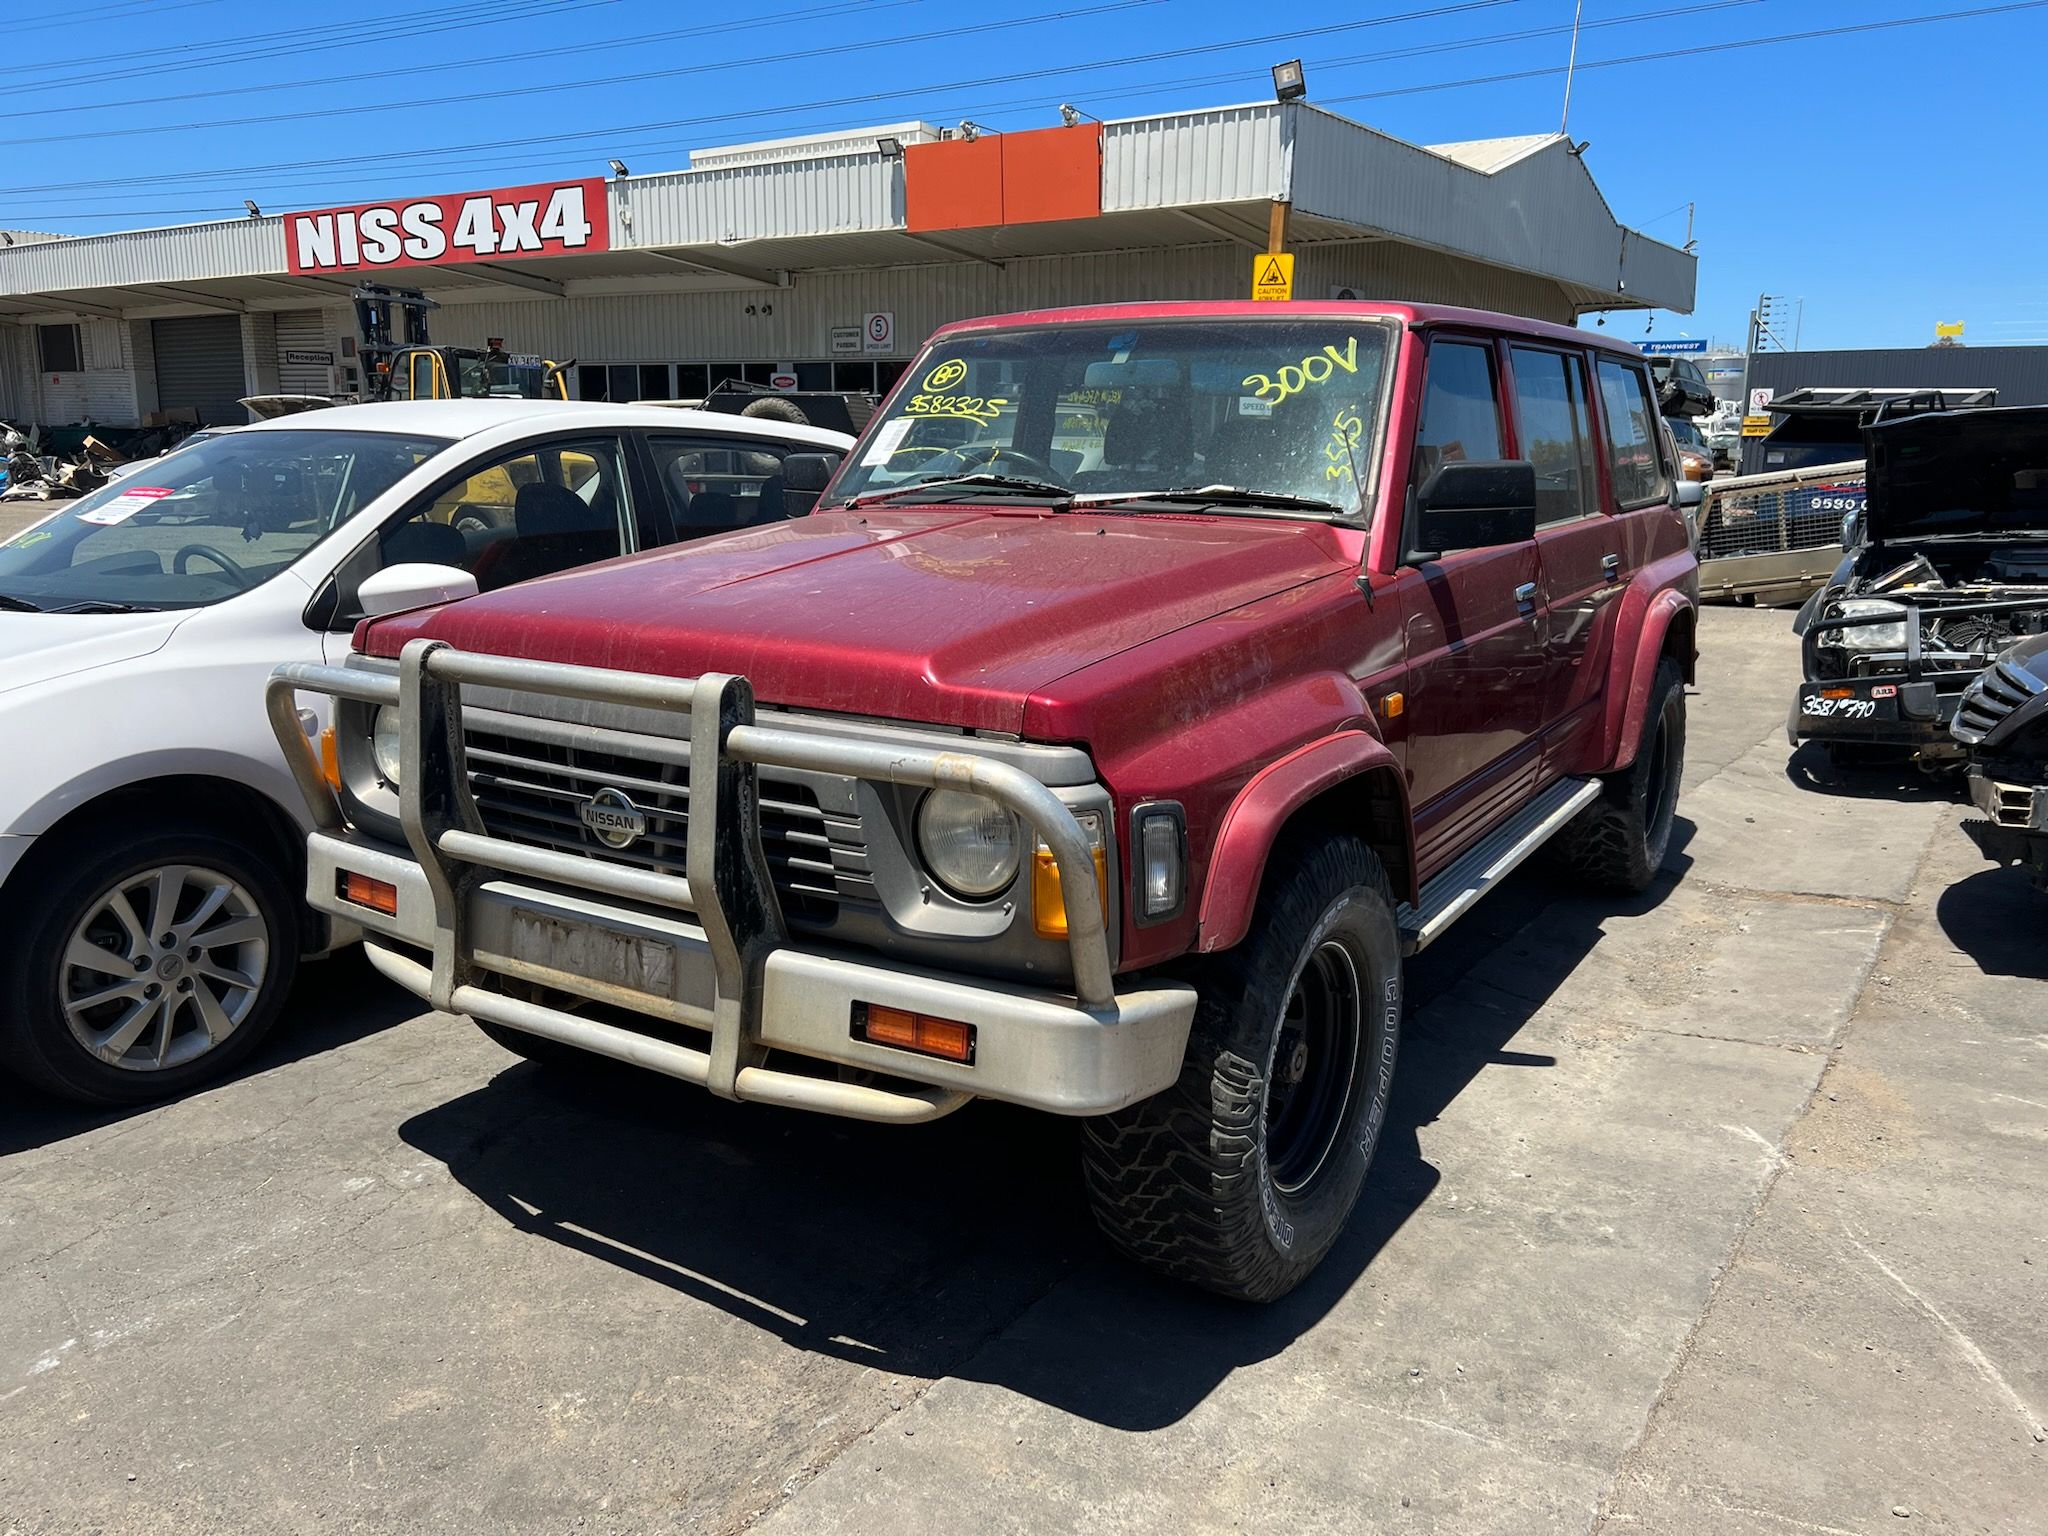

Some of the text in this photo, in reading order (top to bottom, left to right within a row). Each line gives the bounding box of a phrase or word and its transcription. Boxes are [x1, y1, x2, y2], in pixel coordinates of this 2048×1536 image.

[295, 185, 592, 268] NISS 4x4
[875, 319, 883, 333] 5
[289, 353, 330, 362] Reception
[905, 394, 1008, 417] 3582325
[1242, 402, 1265, 411] SPEED
[586, 809, 635, 830] NISSAN
[1359, 976, 1398, 1160] COOPER
